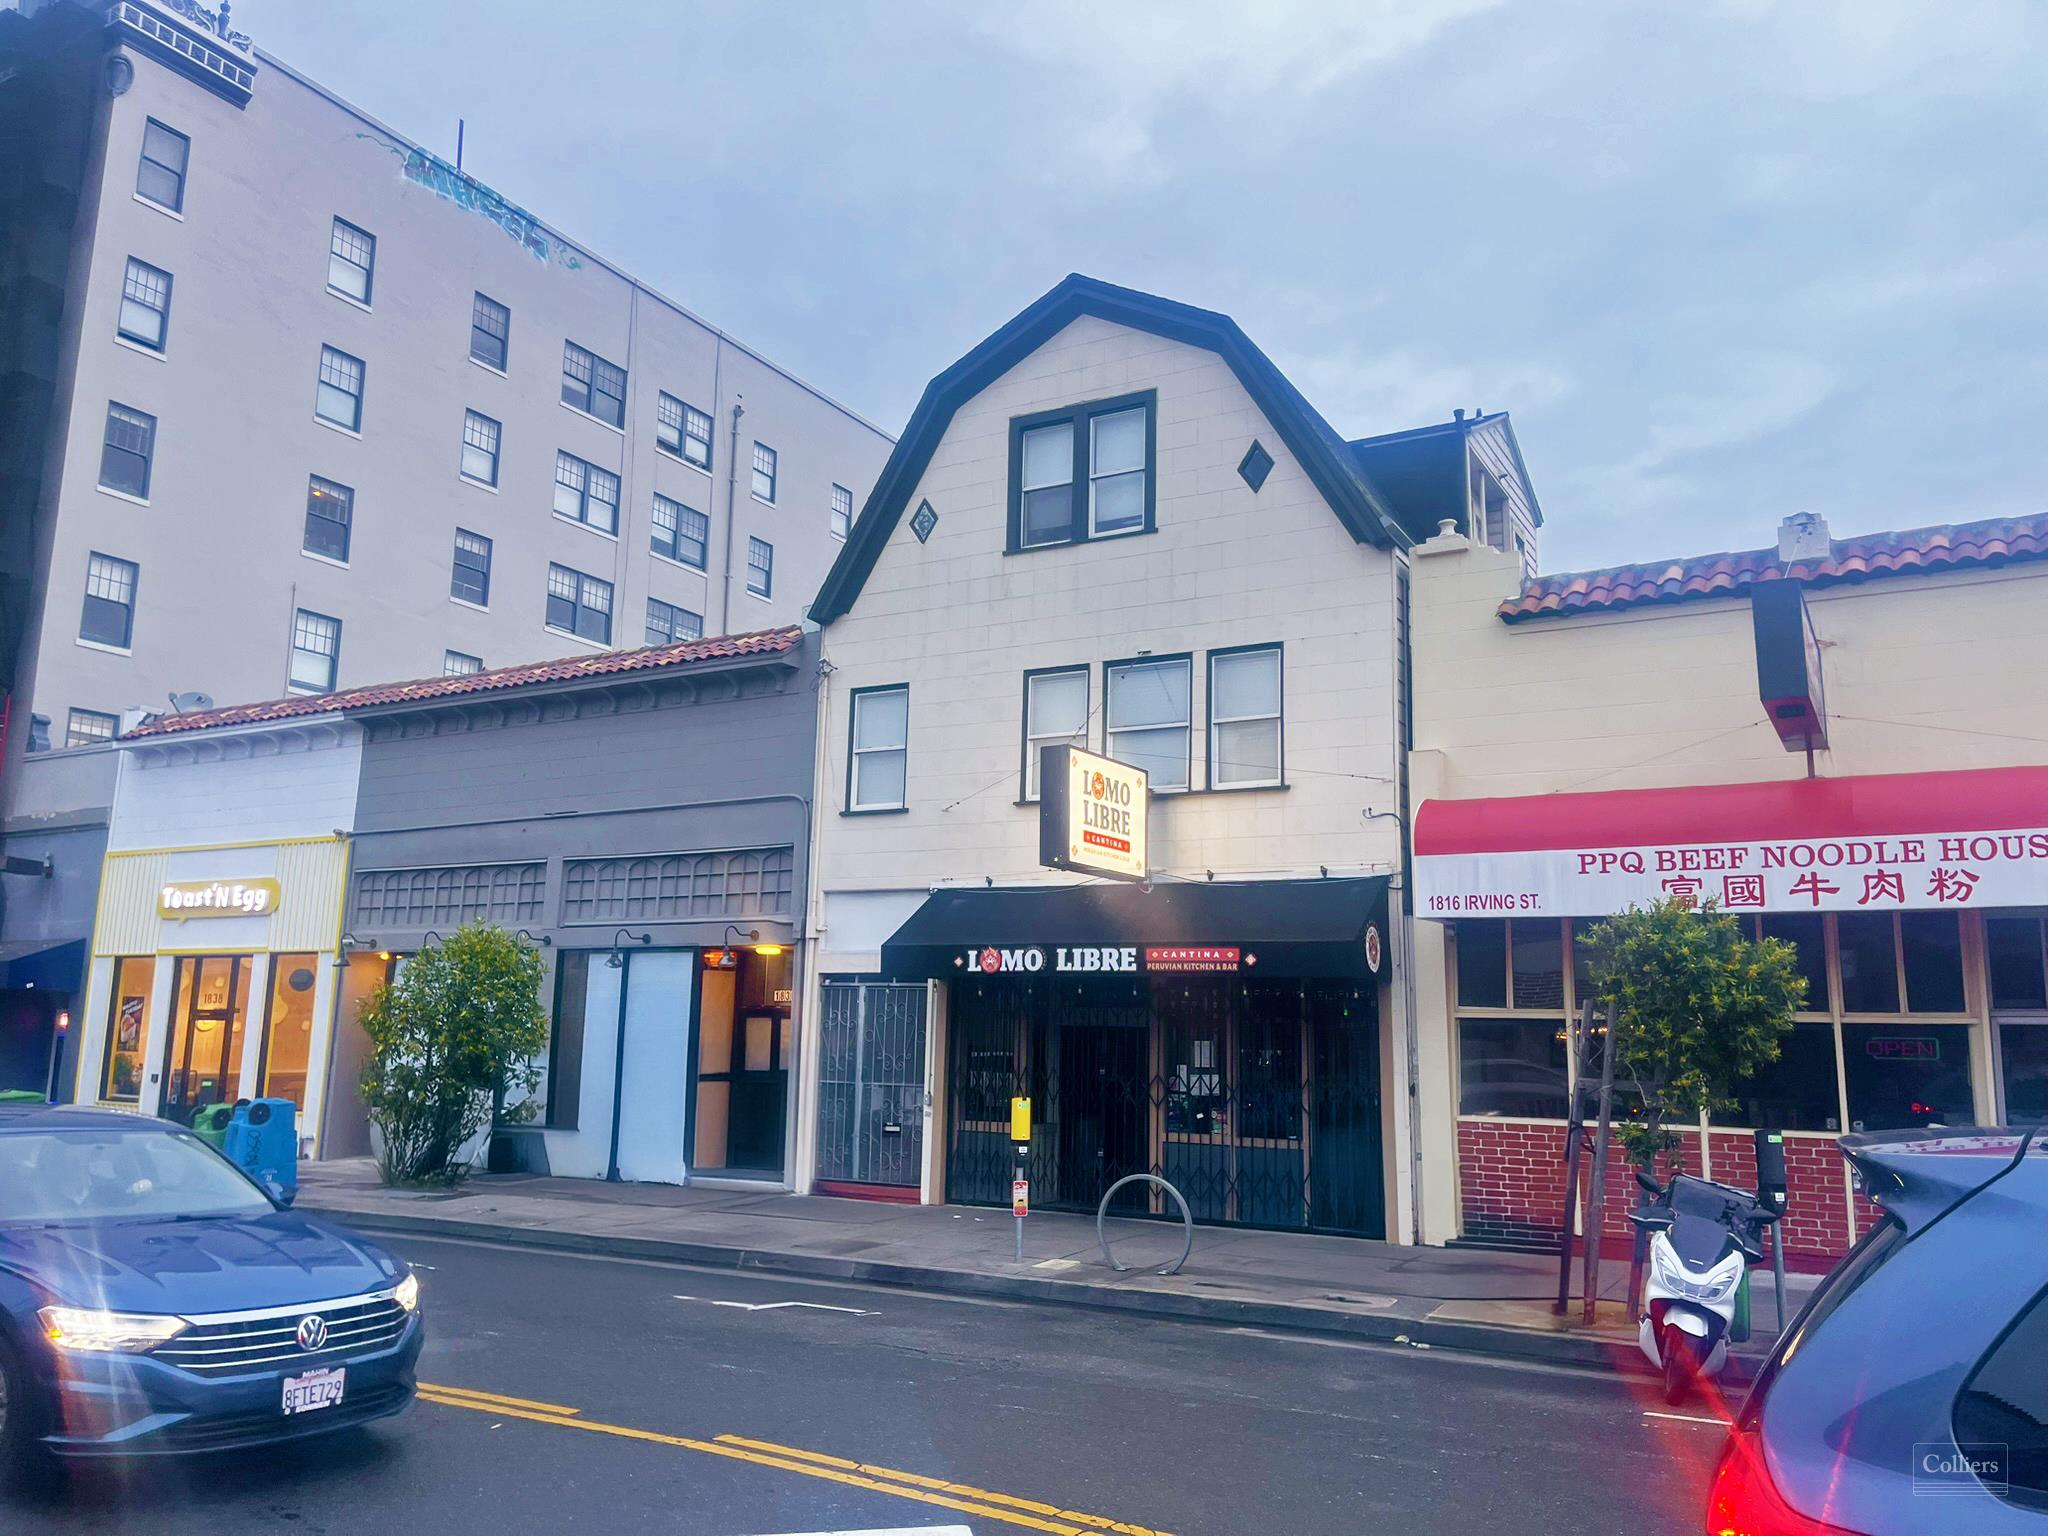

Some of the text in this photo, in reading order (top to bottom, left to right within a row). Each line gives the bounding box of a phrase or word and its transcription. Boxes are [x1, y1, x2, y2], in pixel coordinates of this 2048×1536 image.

[1083, 770, 1130, 806] LOMO
[1083, 800, 1130, 836] LIBRE
[1091, 834, 1122, 849] CANTINA
[1577, 834, 2048, 875] PPQ BEEF NOODLE HOUS
[162, 882, 267, 912] Toast'N Egg
[1428, 893, 1542, 911] 1816 IRVING ST.
[967, 947, 1137, 974] LOMO LIBRE
[1162, 951, 1220, 959] CANTINA
[1146, 962, 1182, 971] PERUVIAN
[1183, 962, 1214, 971] KITCHEN
[1222, 962, 1238, 971] BAR
[204, 993, 224, 1005] 1838
[775, 990, 792, 1001] 183
[1866, 1040, 1935, 1056] OPEN
[284, 1380, 342, 1408] 8FTE729
